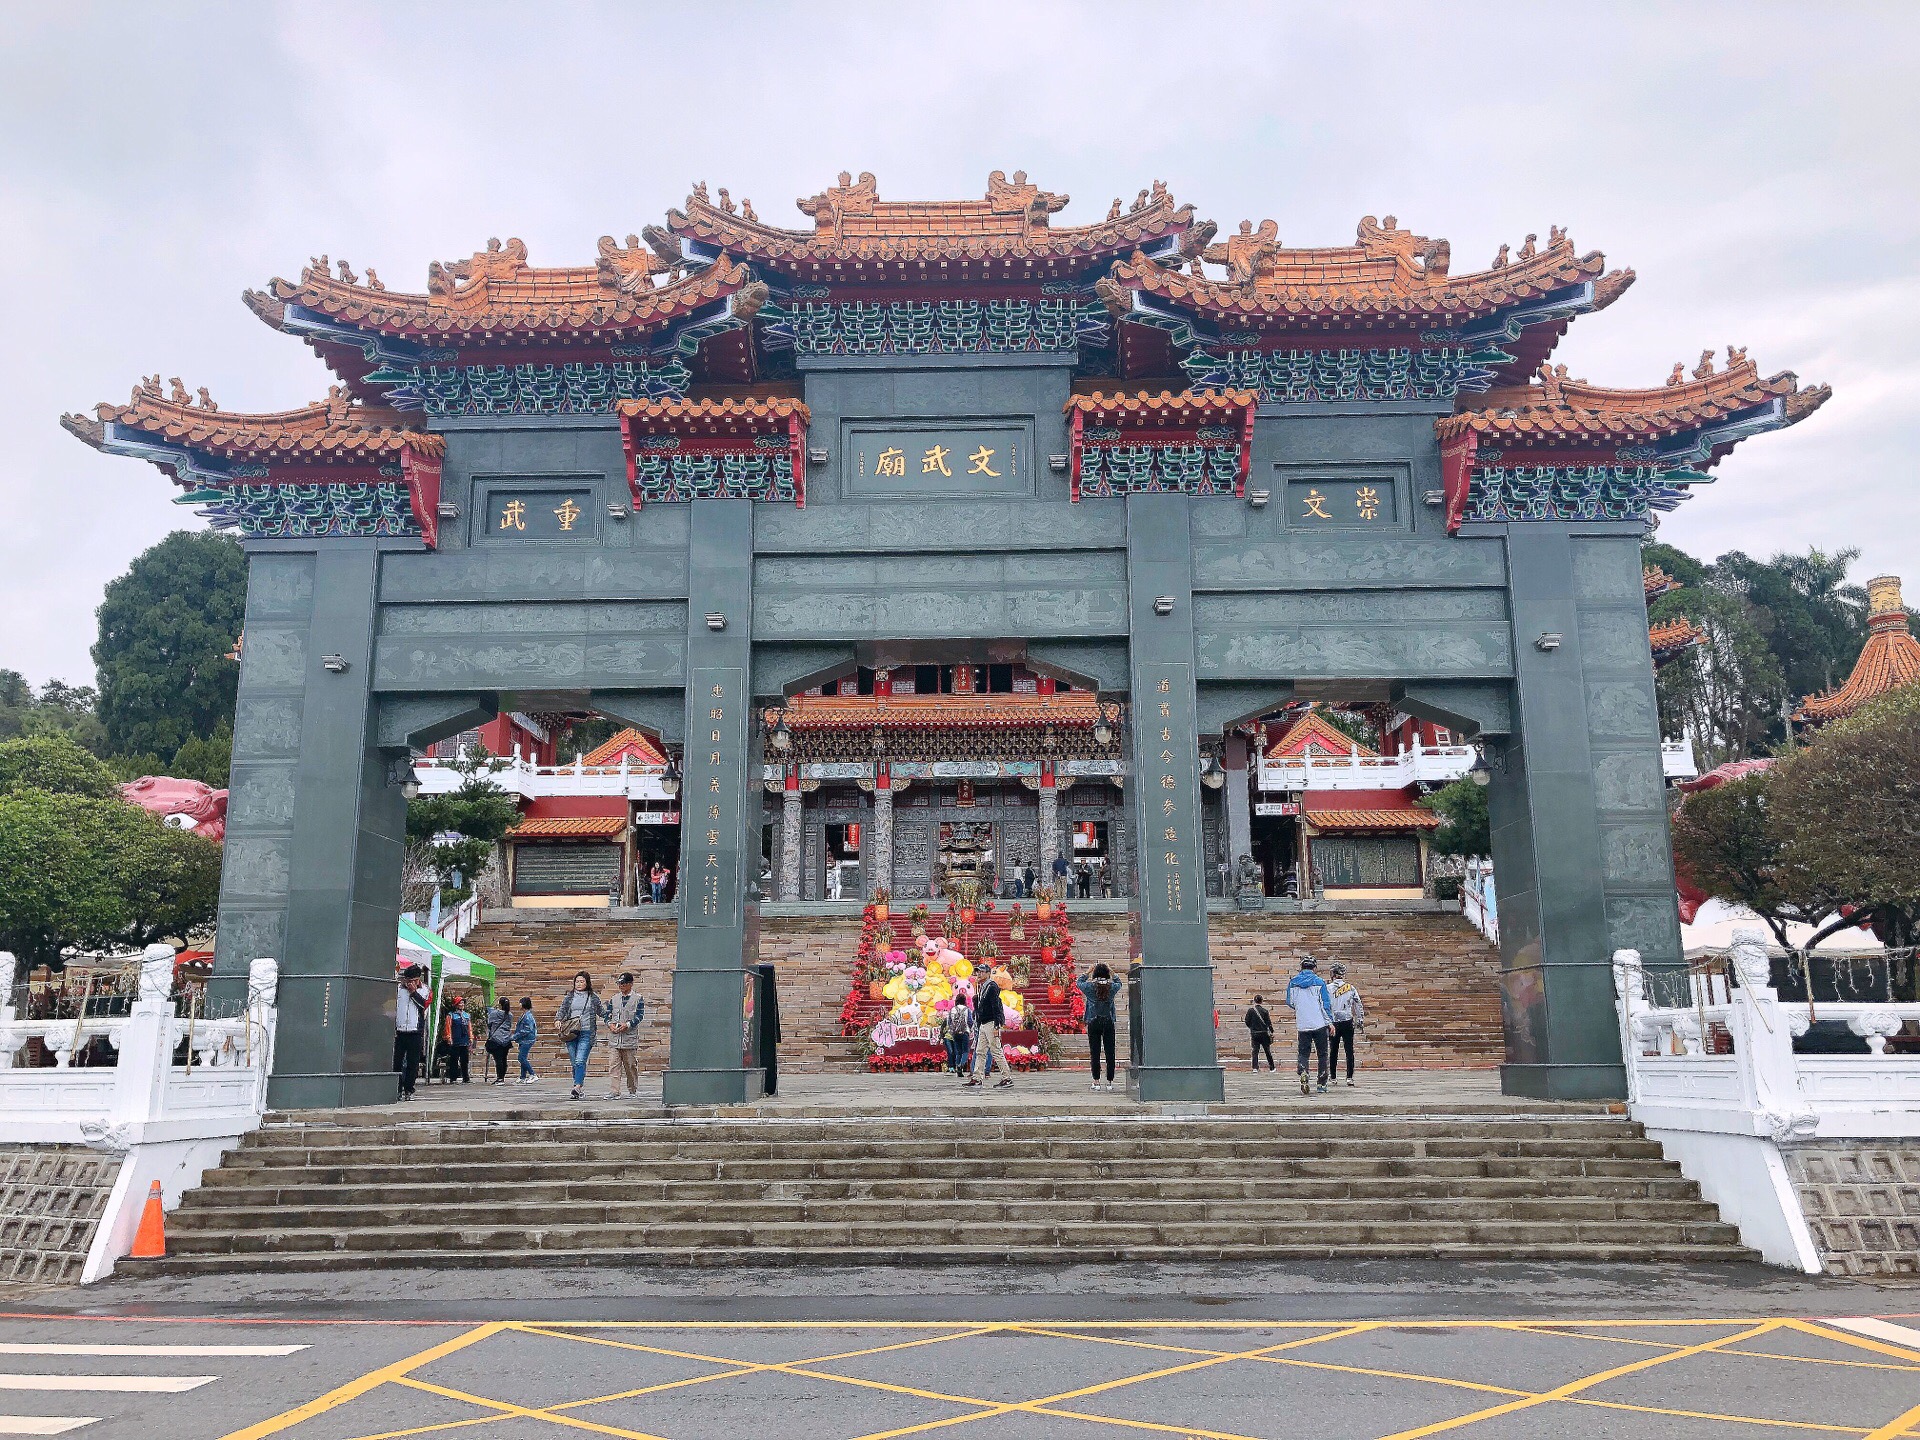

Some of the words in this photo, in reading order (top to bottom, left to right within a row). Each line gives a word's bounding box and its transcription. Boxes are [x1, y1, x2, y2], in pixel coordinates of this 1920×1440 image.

[873, 445, 1002, 477] 文武廟
[499, 499, 581, 531] 重武
[1302, 486, 1380, 520] 崇文
